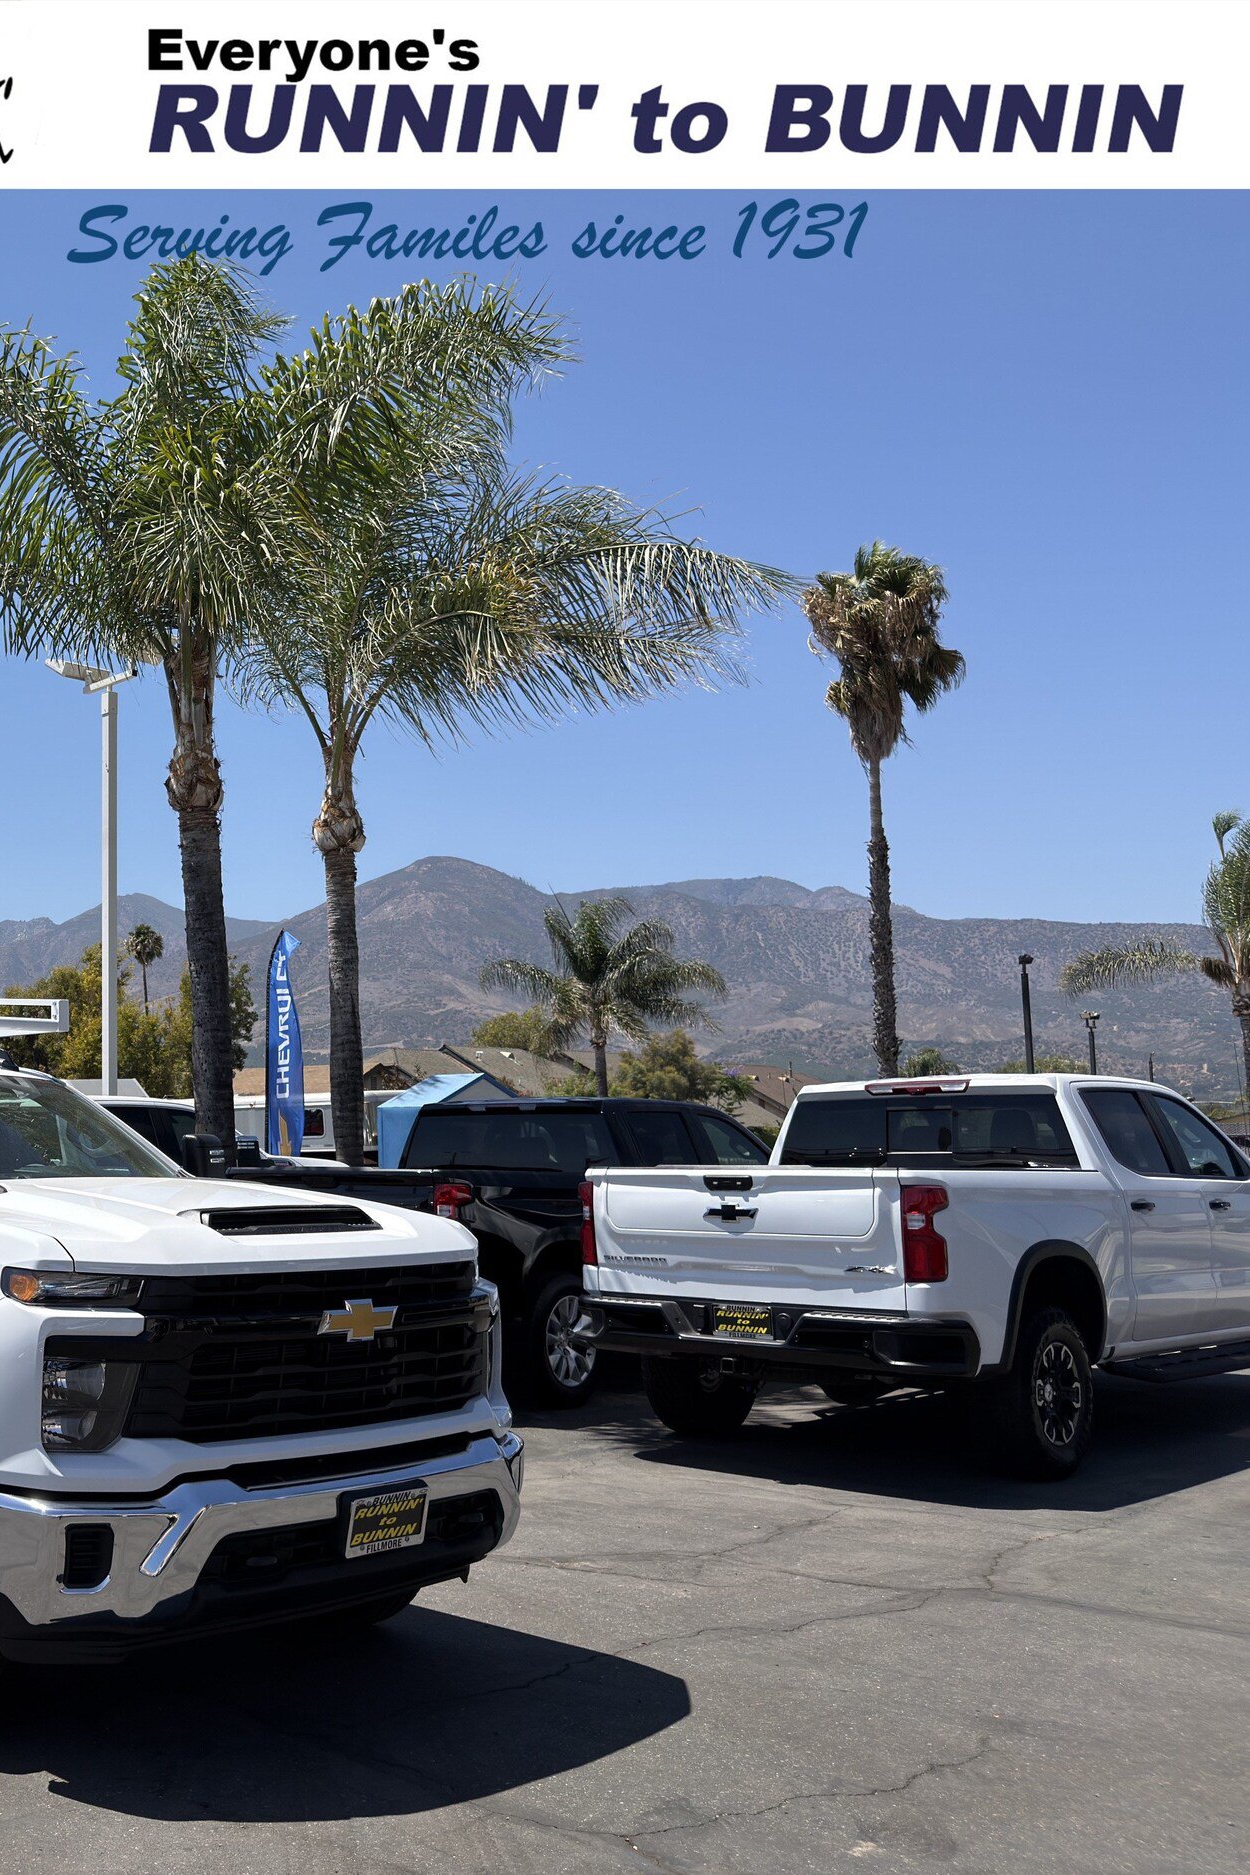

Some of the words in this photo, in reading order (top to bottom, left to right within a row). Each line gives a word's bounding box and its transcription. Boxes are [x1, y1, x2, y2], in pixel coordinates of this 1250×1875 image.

[716, 1310, 769, 1319] RUNNIN'
[718, 1323, 768, 1334] BUNNIN
[372, 1490, 412, 1506] BUNNIN
[354, 1498, 424, 1520] RUNNIN'
[378, 1516, 398, 1526] to
[351, 1522, 418, 1547] BUNNIN
[366, 1538, 403, 1554] FILLMORE
